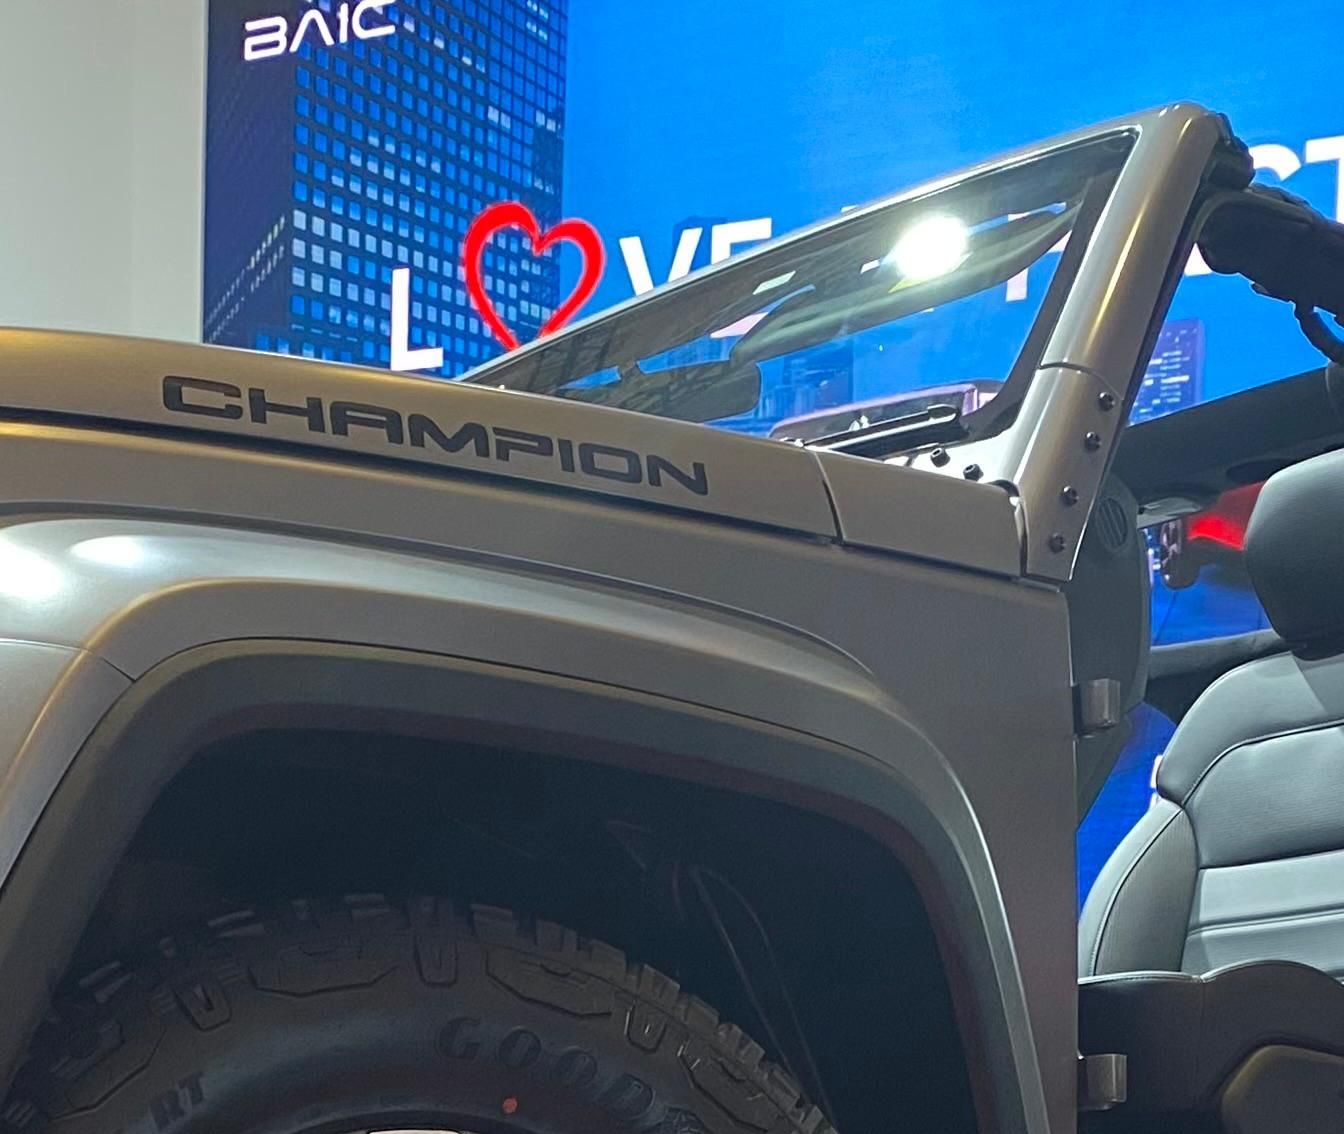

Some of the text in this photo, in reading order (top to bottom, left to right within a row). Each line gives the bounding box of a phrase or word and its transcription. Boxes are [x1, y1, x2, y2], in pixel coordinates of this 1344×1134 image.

[243, 0, 397, 61] BAIC
[162, 375, 709, 496] CHAMPION
[149, 1071, 208, 1132] RT
